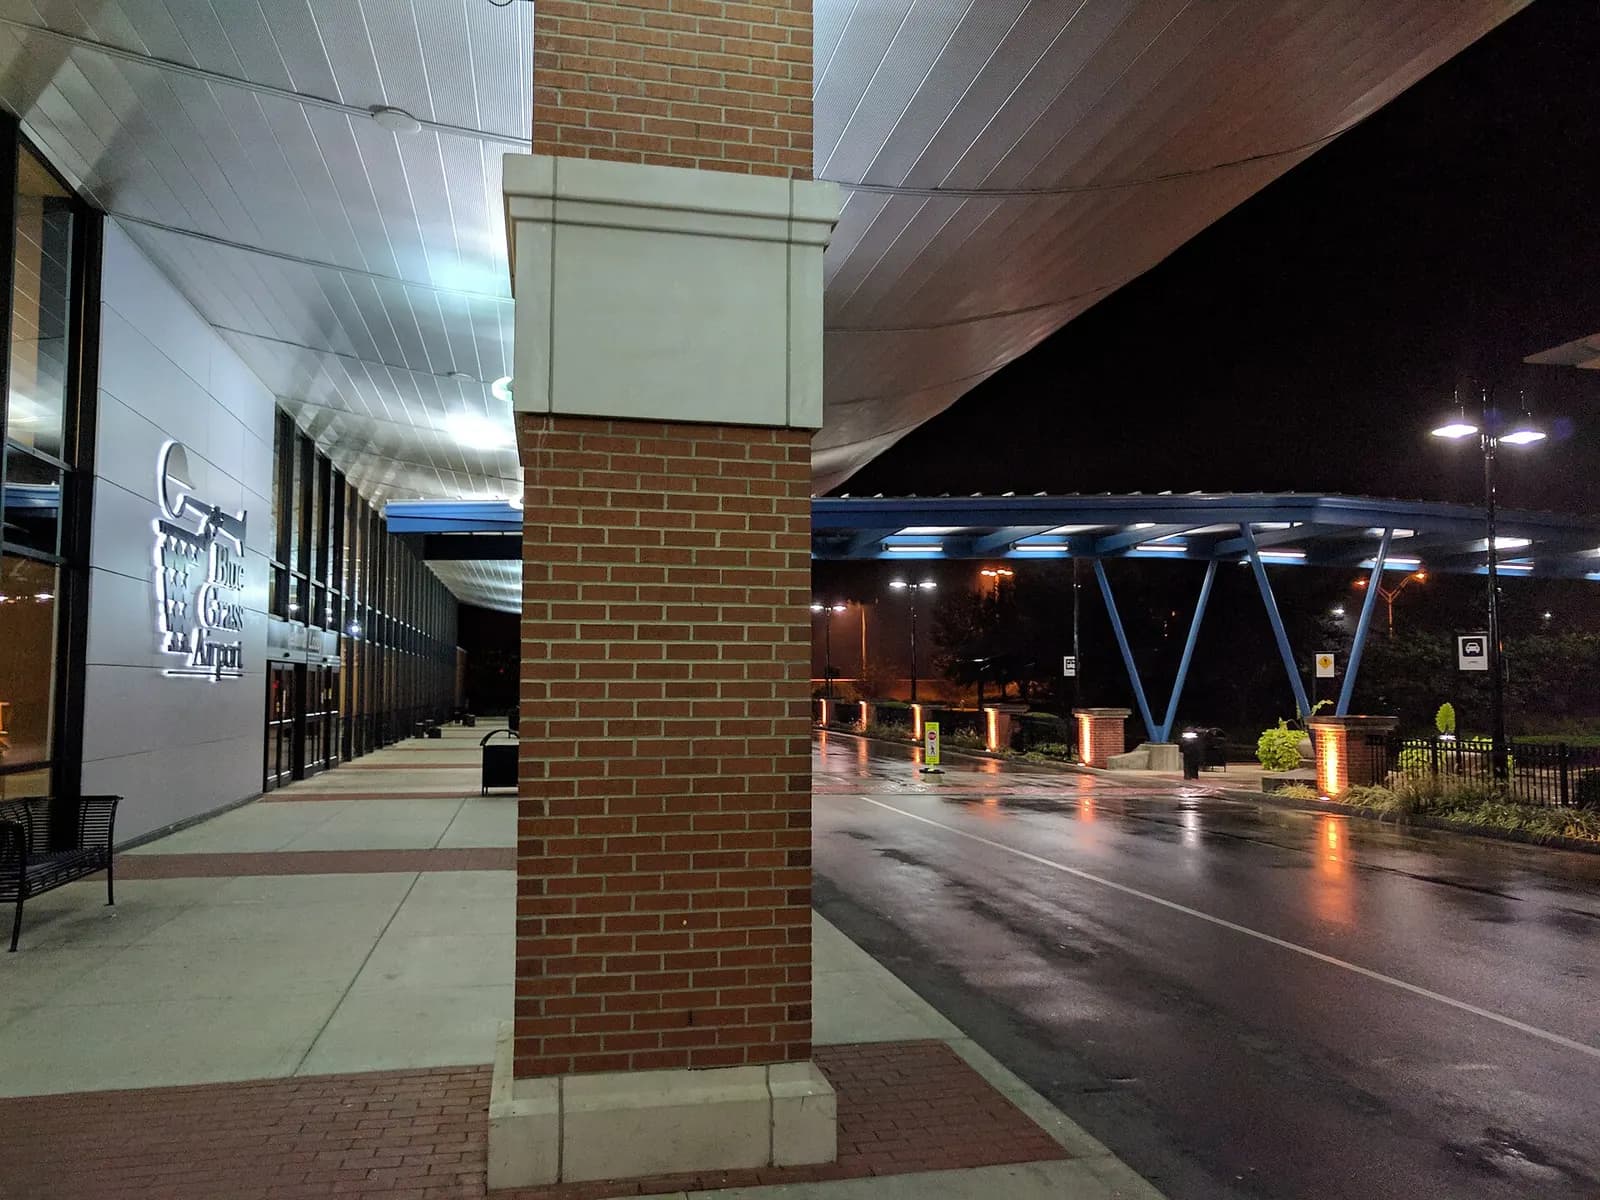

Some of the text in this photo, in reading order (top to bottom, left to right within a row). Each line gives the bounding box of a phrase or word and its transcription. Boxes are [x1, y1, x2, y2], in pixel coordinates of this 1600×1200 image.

[211, 542, 244, 590] Blue
[202, 584, 243, 631] Grass
[192, 628, 243, 681] Airport
